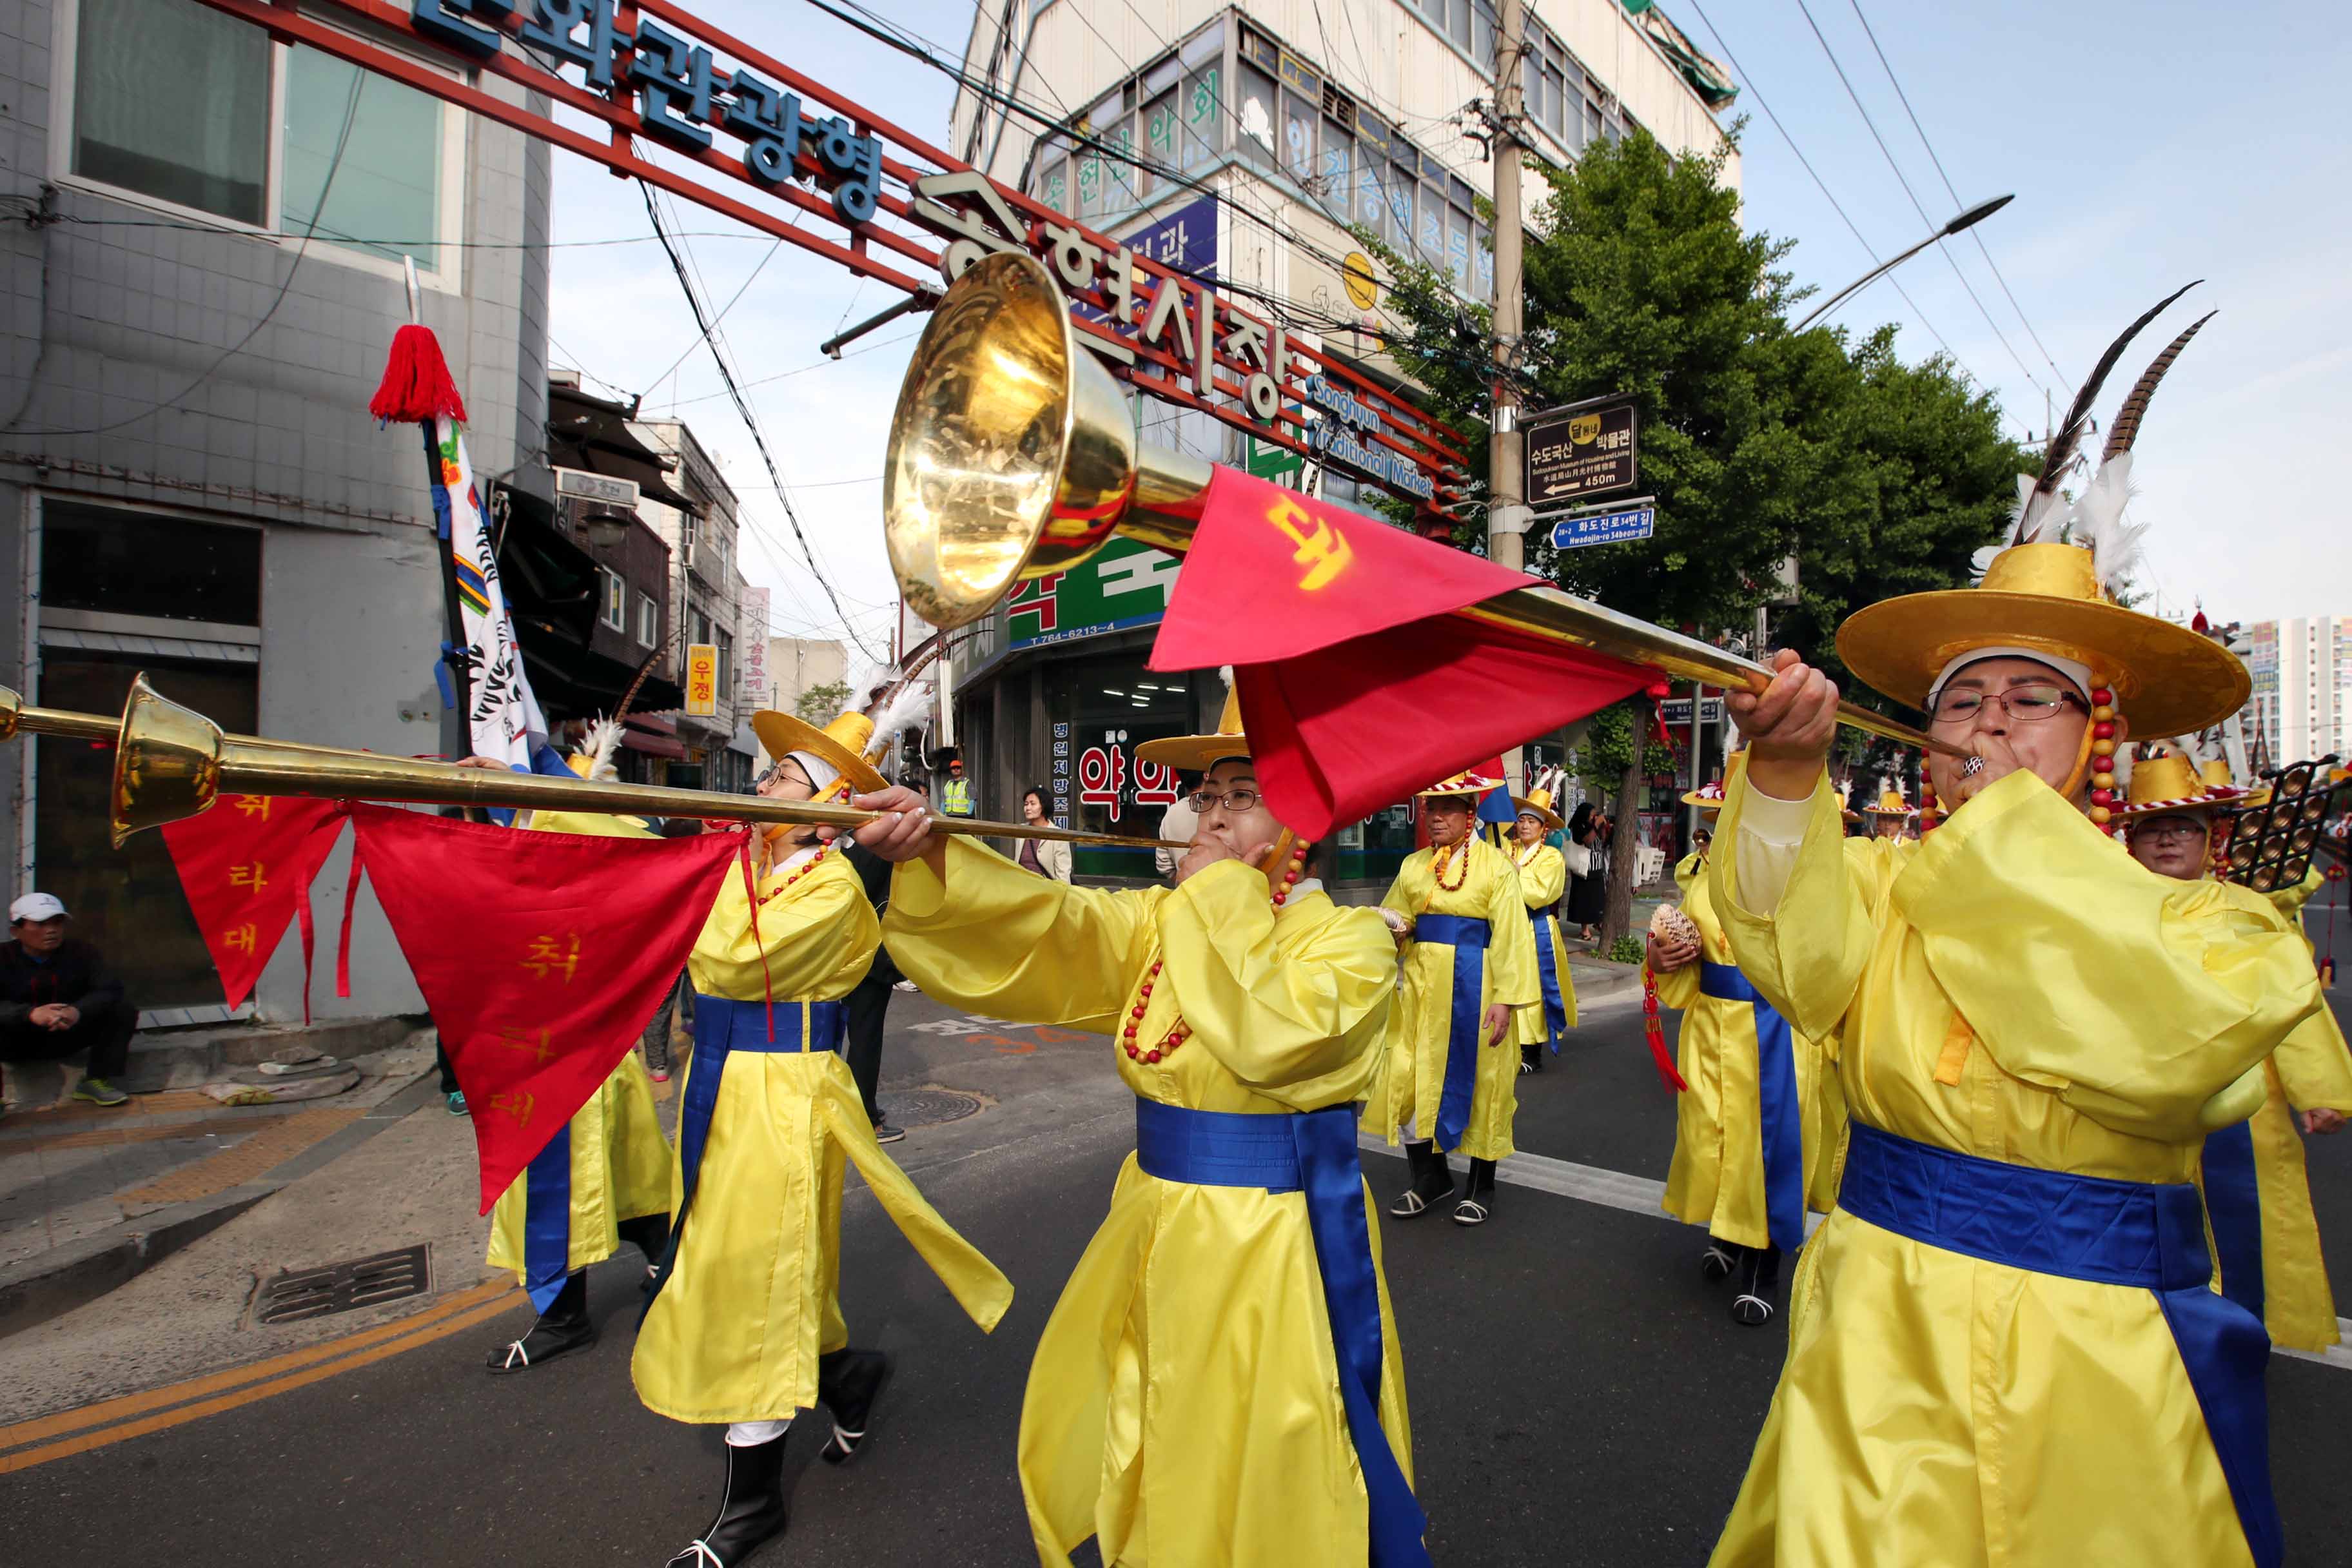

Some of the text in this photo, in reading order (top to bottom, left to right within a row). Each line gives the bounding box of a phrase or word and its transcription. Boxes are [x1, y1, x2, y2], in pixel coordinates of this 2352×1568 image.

[908, 170, 1293, 420] 송현시장
[1307, 375, 1380, 433] Songhyun
[1531, 441, 1573, 466] 수도국산
[1596, 428, 1631, 451] 박물관
[1391, 456, 1434, 500] Market
[1585, 474, 1616, 487] 450m
[1569, 533, 1610, 545] Hwadojin-ro
[694, 660, 710, 700] 우정
[1079, 744, 1126, 823] 약
